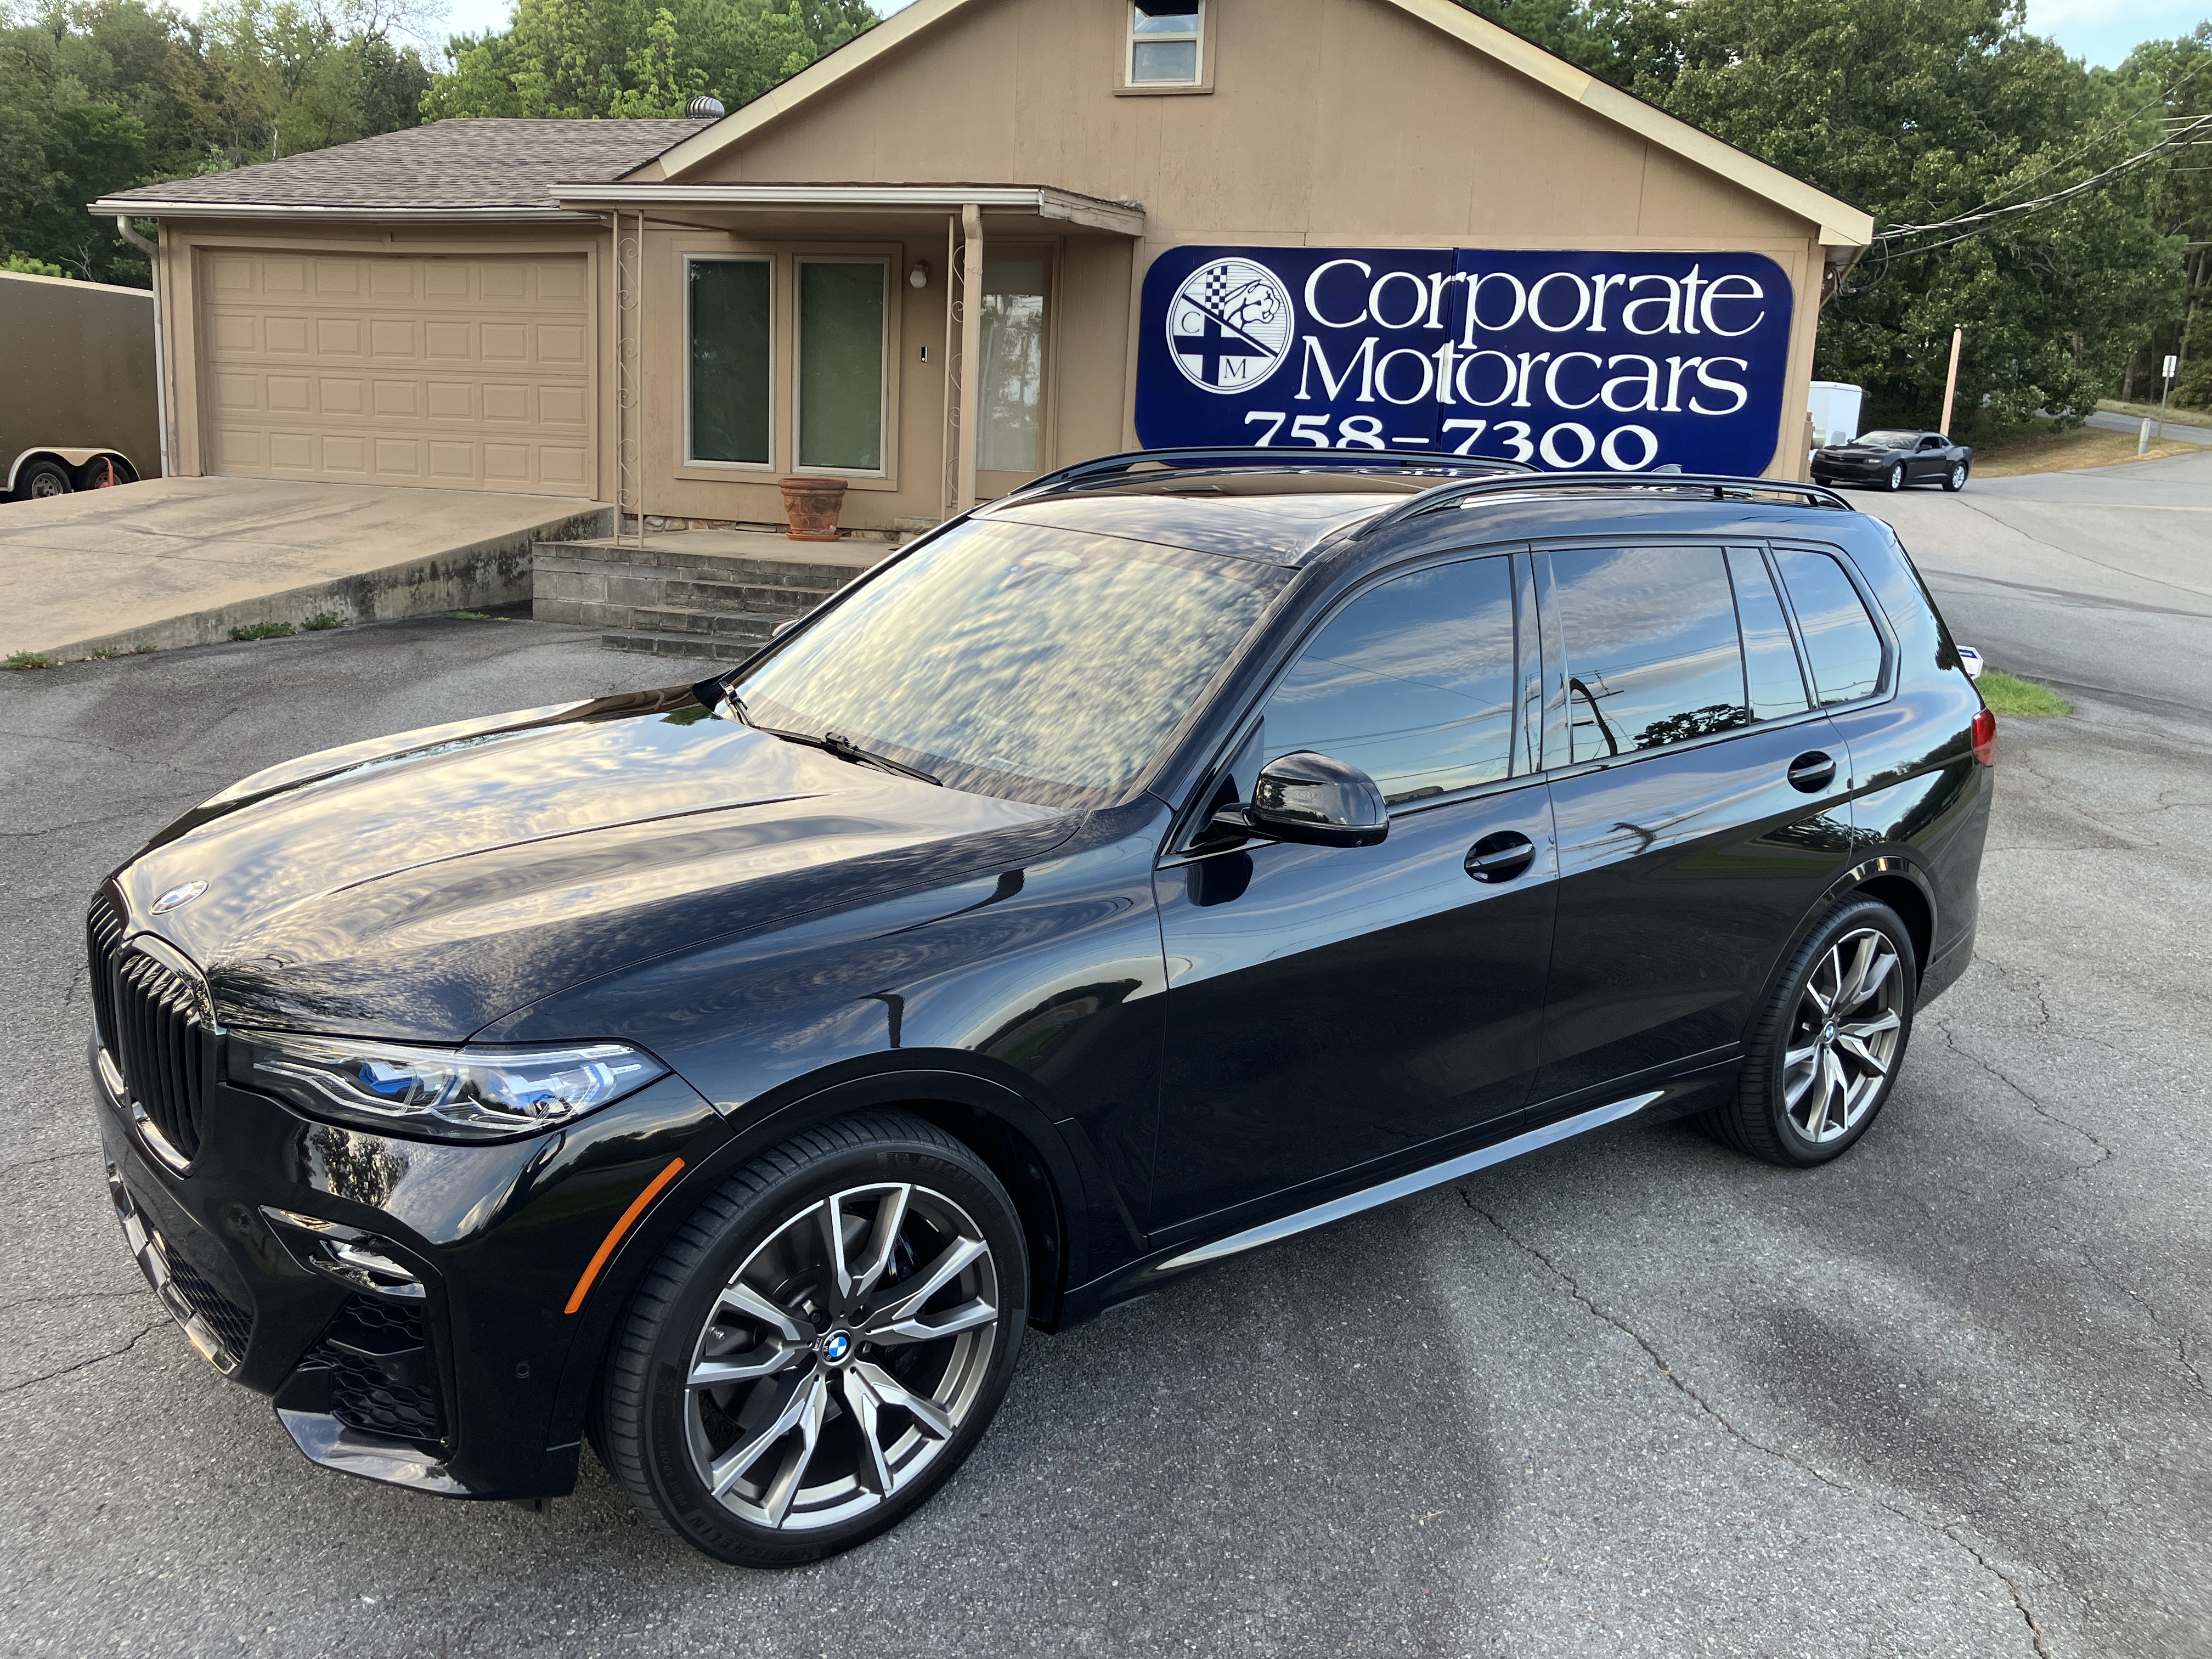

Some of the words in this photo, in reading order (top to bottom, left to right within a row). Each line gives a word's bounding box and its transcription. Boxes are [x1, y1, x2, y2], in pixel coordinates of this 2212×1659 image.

[1181, 311, 1200, 333] C
[1304, 258, 1765, 349] Corporate
[1223, 358, 1246, 379] M
[1294, 336, 1748, 415] Motorcars
[1244, 411, 1658, 471] 758-7300
